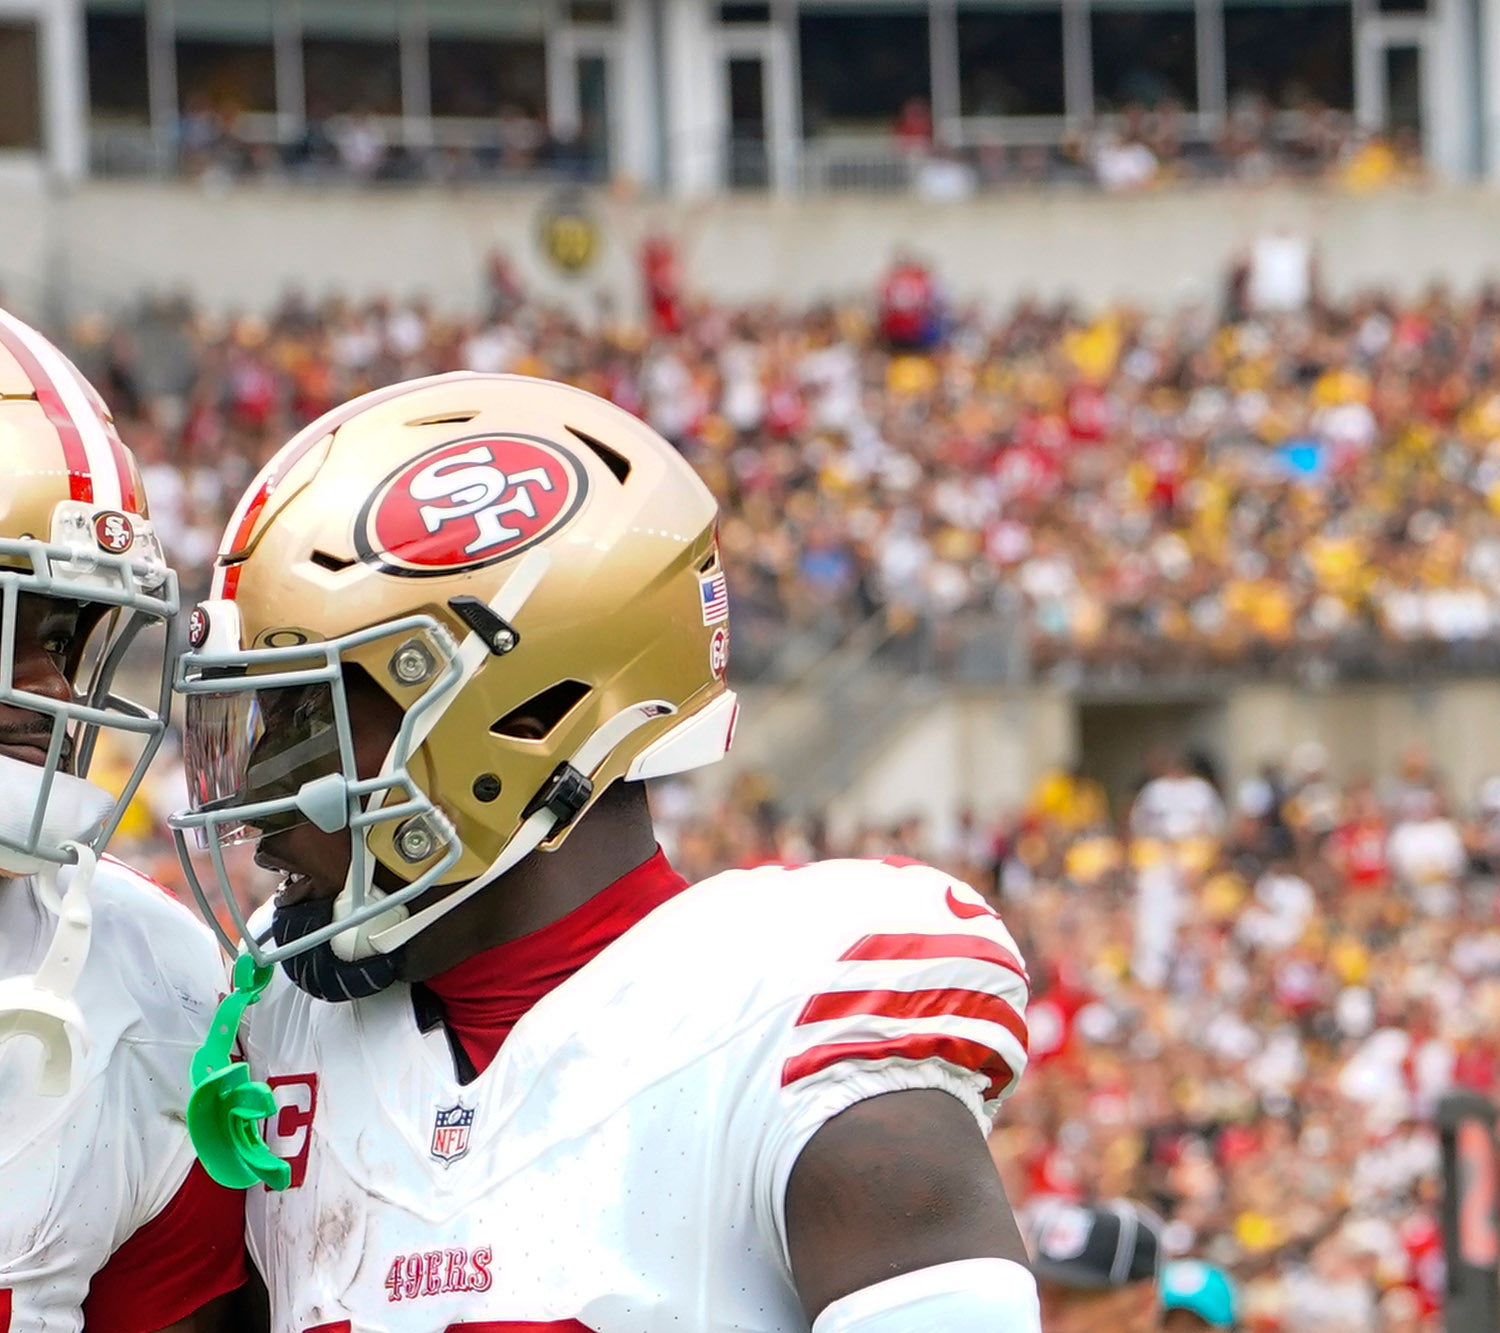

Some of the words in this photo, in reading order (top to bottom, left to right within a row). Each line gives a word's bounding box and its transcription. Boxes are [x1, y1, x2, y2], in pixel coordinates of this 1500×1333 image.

[409, 446, 553, 555] SF
[265, 1082, 311, 1158] C
[435, 1128, 465, 1154] NFL
[386, 1247, 493, 1301] 49ERS
